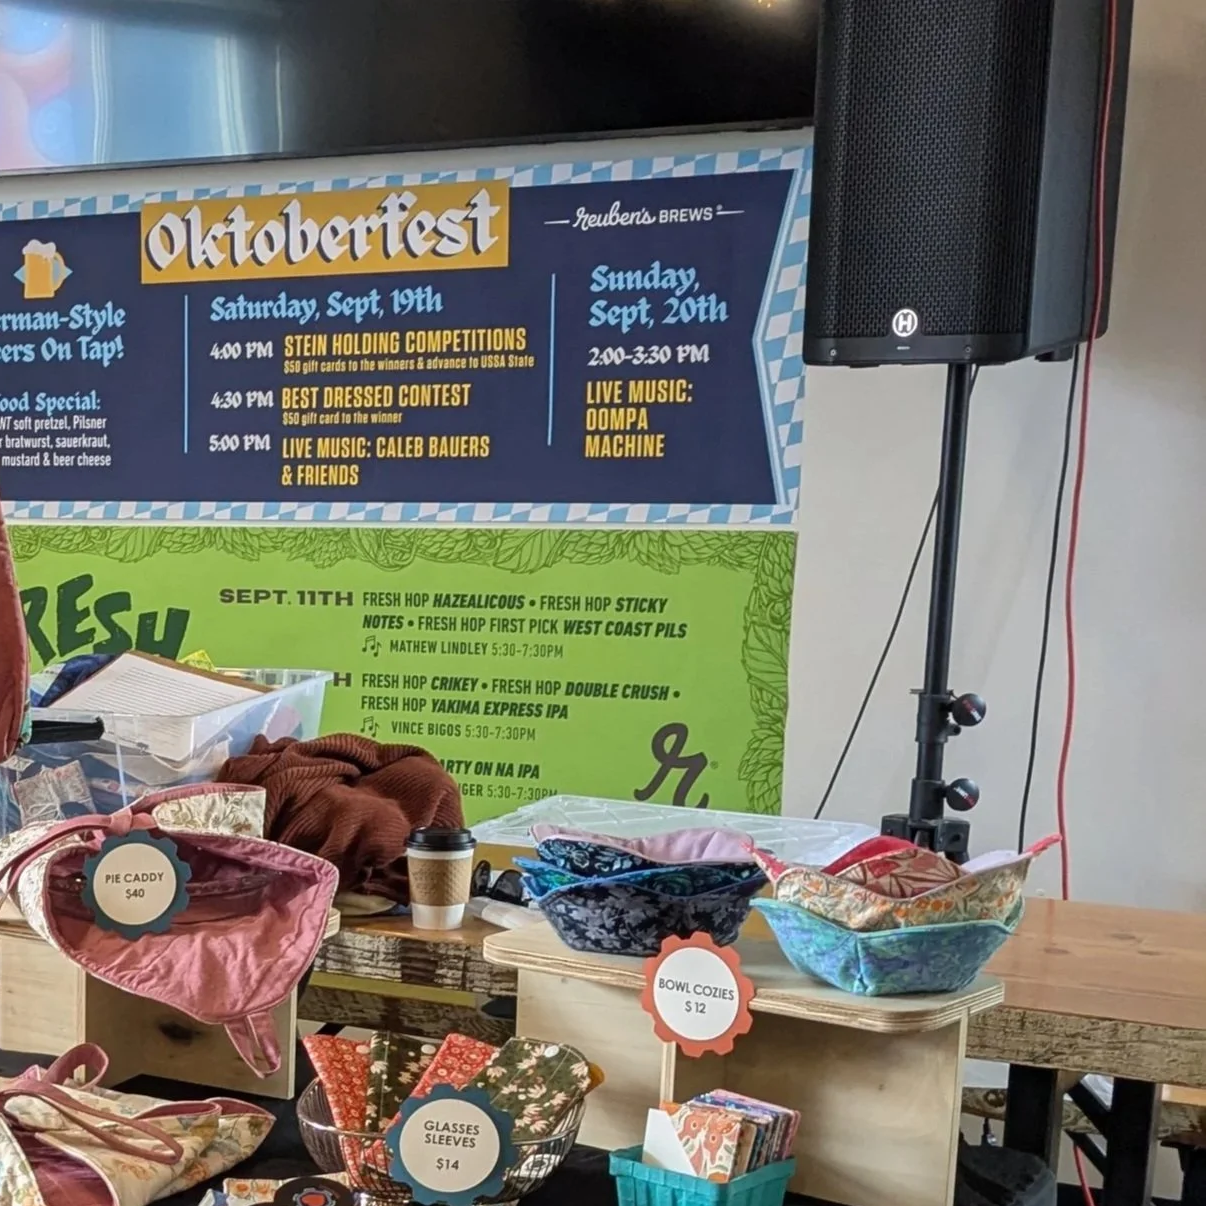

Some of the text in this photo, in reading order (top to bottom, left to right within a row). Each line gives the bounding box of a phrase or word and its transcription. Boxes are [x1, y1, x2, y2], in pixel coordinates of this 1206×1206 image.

[659, 207, 713, 223] BREWS
[147, 188, 500, 271] Oktoberfest
[589, 260, 699, 296] Sunday,
[210, 291, 321, 325] Saturday,
[389, 285, 444, 315] 19th
[661, 293, 729, 324] 20th
[41, 337, 72, 362] On
[76, 335, 125, 368] Tap!
[210, 341, 274, 360] 4:00 PM
[284, 327, 527, 357] STEIN HOLDING COMPETITIONS
[284, 354, 535, 375] $50 gift cards to the winners & advance to USSA State
[587, 344, 710, 366] 2:00-3:30 PM
[210, 390, 274, 409] 4:30 PM
[282, 383, 472, 409] BEST DRESSED CONTEST
[586, 379, 693, 404] LIVE MUSIC:
[35, 390, 101, 416] Special:
[13, 415, 32, 430] soft
[34, 415, 71, 432] pretzel,
[73, 414, 107, 429] Pilsner
[282, 411, 403, 426] $50 gift card to the winner
[586, 407, 648, 431] OOMPA
[5, 434, 53, 449] bratwurst,
[56, 434, 111, 449] sauerkraut,
[209, 434, 271, 452] 5:00 PM
[282, 435, 490, 459] LIVE MUSIC: CALEB BAUERS
[585, 434, 665, 458] MACHINE
[1, 453, 40, 467] mustard
[43, 453, 51, 466] &
[53, 452, 76, 466] beer
[77, 451, 112, 466] cheese
[281, 464, 360, 486] & FRIENDS
[219, 588, 668, 614] SEPT. 11TH FRESH HOP HAZEALICOUS FRESH HOP STICKY
[19, 573, 190, 666] RESH
[362, 614, 688, 639] NOTES FRESH HOP FIRST PICK WEST COAST PILS
[390, 639, 564, 658] MATHEW LINDLEY 5:30-7:30PM
[362, 673, 399, 689] FRESH
[402, 674, 428, 690] HOP
[431, 676, 479, 692] CRIKEY
[492, 678, 532, 695] FRESH
[535, 679, 562, 696] HOP
[565, 681, 619, 698] DOUBLE
[621, 683, 670, 701] CRUSH
[361, 695, 569, 719] FRESH HOP YAKIMA EXPRESS IPA
[391, 721, 536, 741] VINCE BIGOS 5:30-7:30PM
[440, 759, 540, 779] RTY ON NA IPA
[458, 783, 483, 797] GER
[105, 872, 164, 884] PIE CADDY
[125, 888, 145, 899] $40
[658, 978, 735, 1001] BOWL COZIES
[424, 1120, 480, 1136] GLASSES
[424, 1133, 476, 1149] SLEEVES
[436, 1158, 460, 1171] $14
